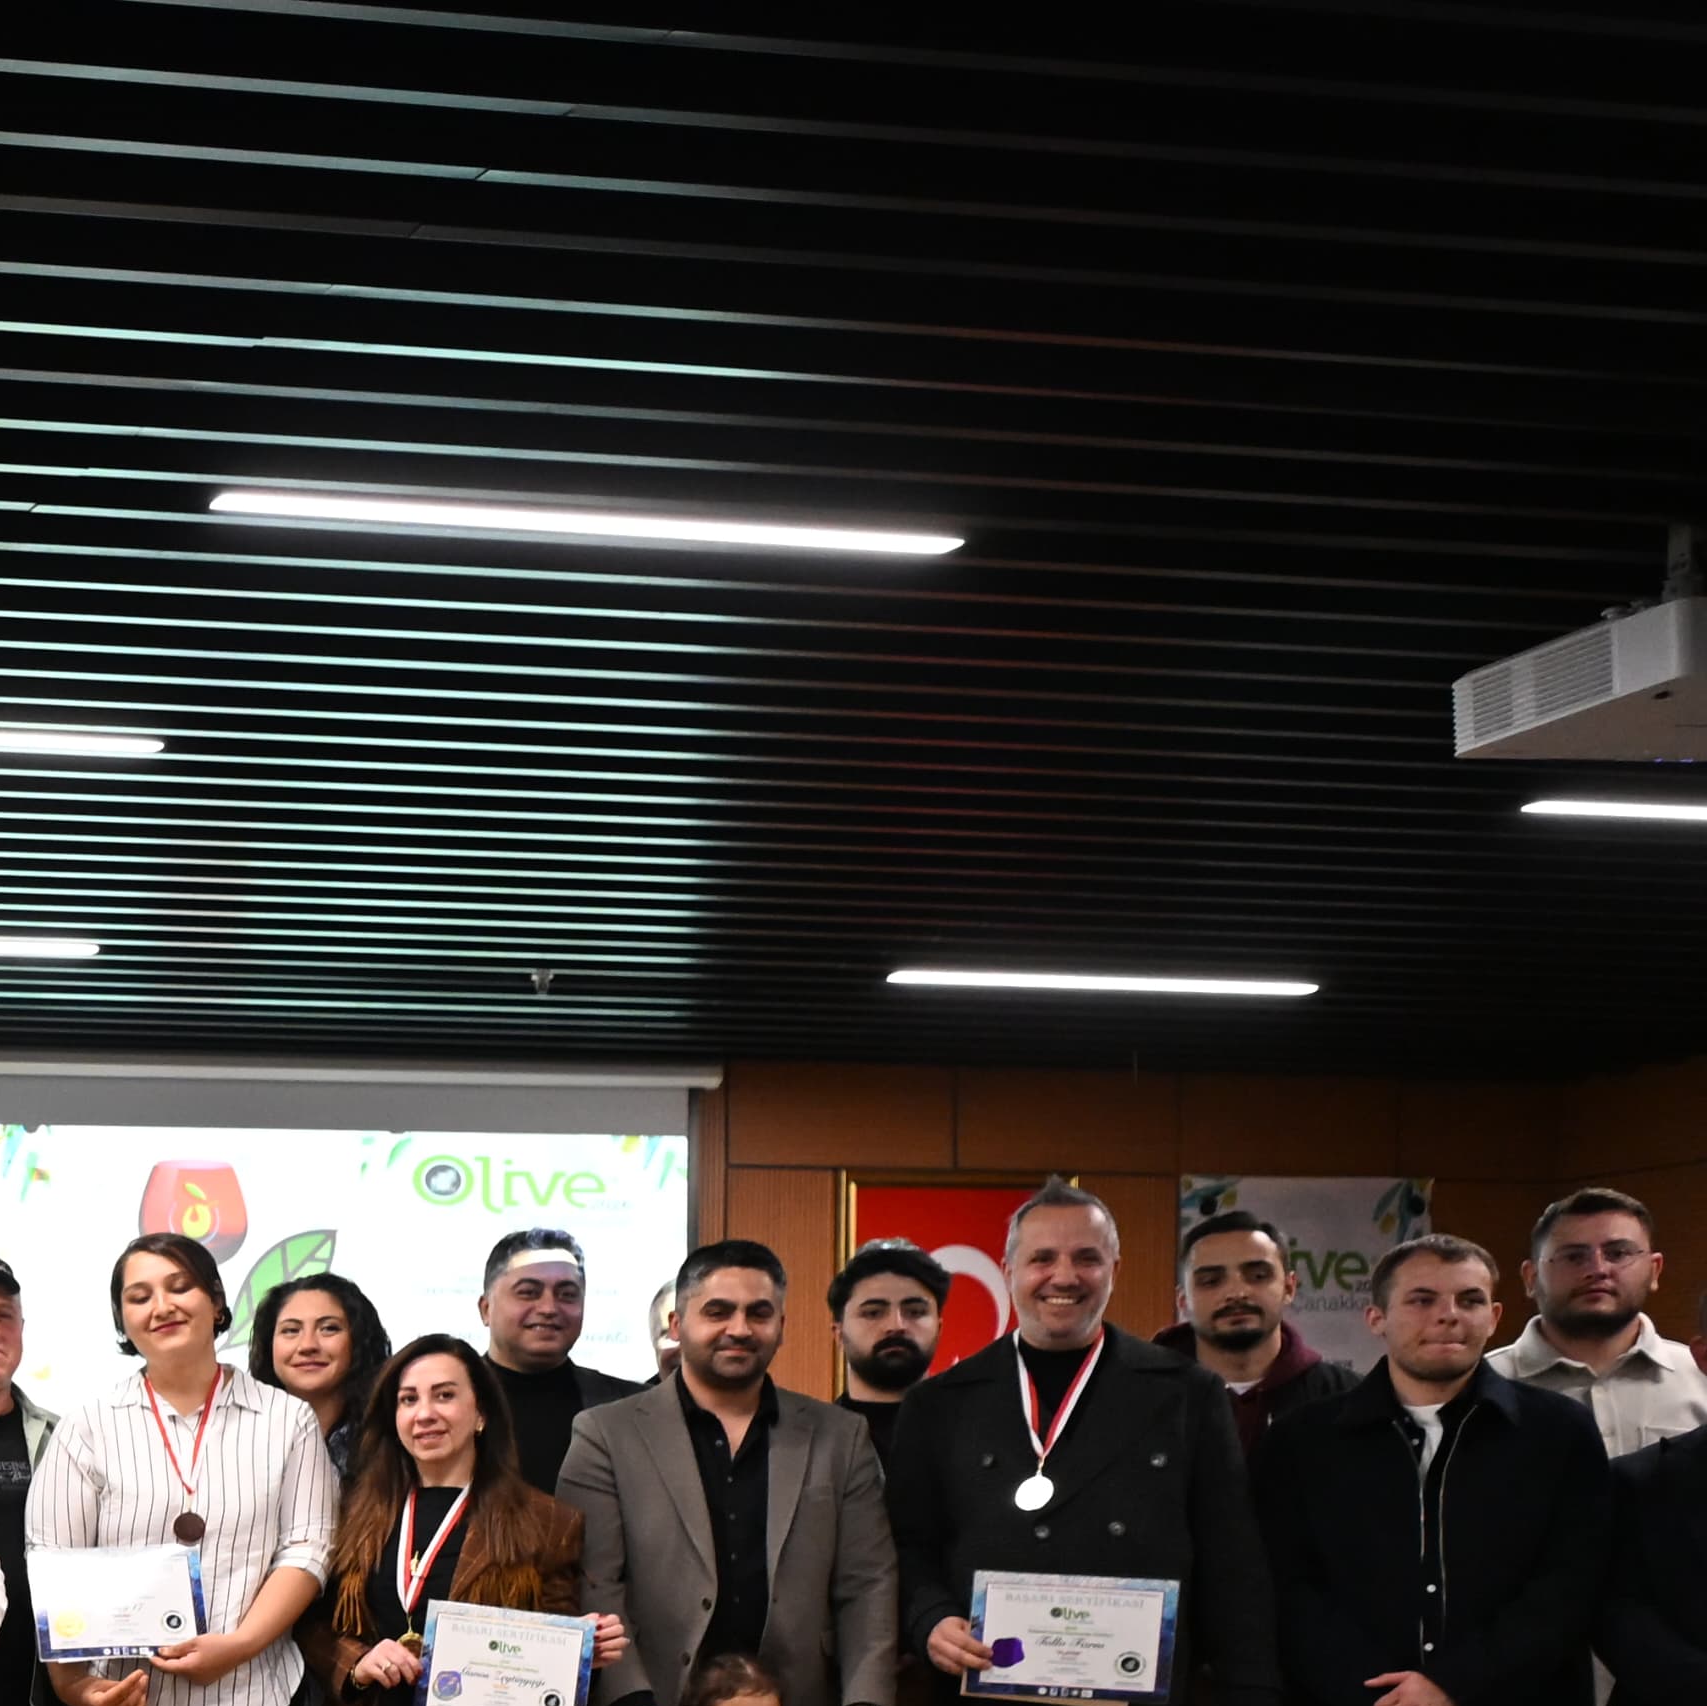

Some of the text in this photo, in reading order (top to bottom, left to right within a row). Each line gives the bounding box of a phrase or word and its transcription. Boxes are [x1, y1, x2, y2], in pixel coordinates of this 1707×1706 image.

[412, 1155, 606, 1214] Olive
[1289, 1238, 1369, 1291] ive
[1050, 1606, 1090, 1621] Olive
[488, 1640, 522, 1655] Olive
